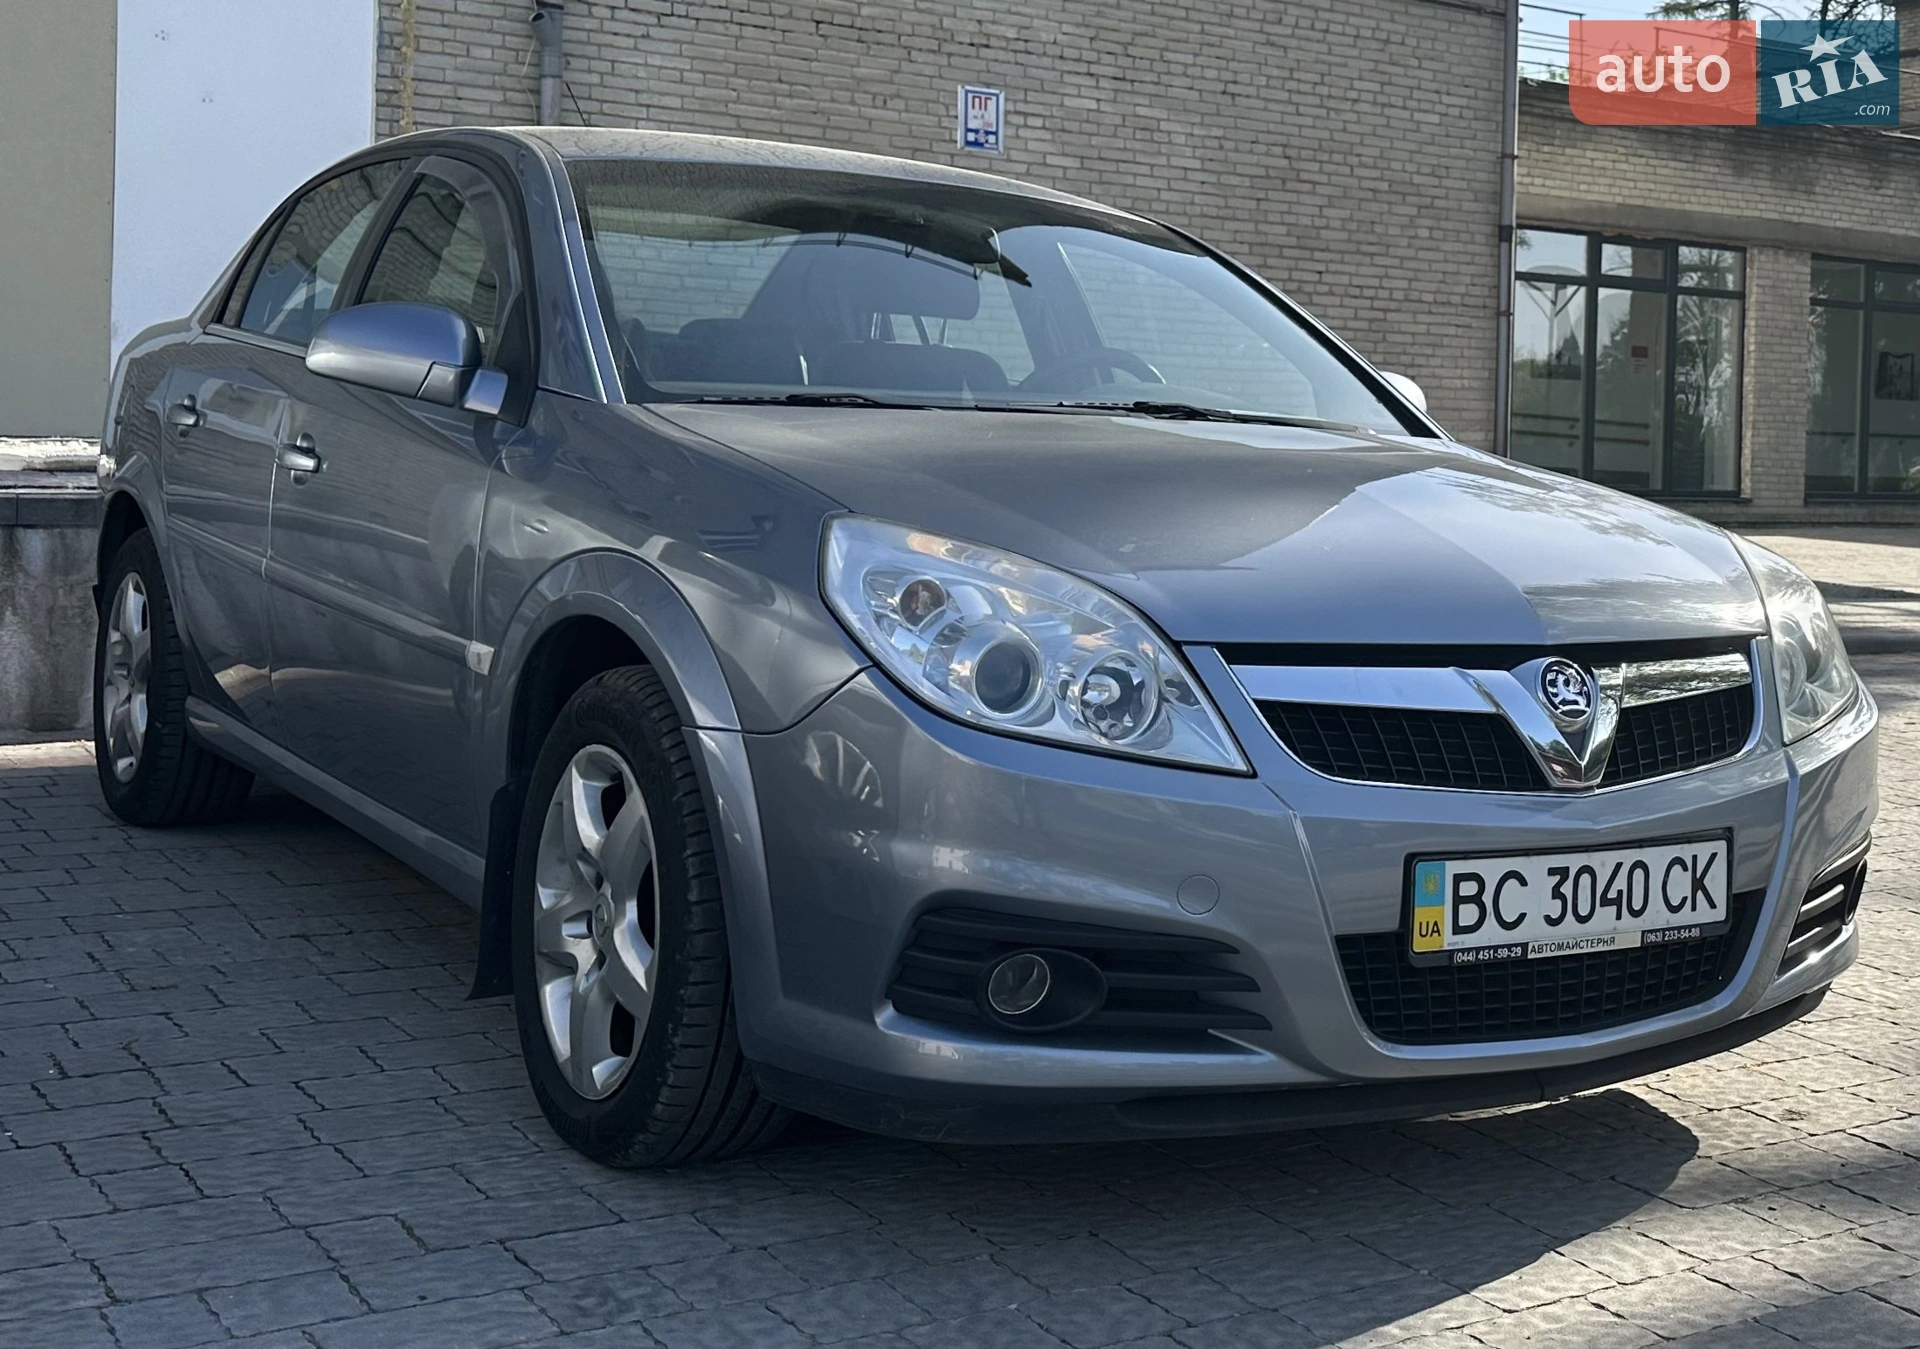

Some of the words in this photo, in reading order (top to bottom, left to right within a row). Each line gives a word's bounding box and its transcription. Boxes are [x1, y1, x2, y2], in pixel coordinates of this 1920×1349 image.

[972, 95, 992, 111] ПГ
[1452, 869, 1529, 936] BC
[1542, 859, 1651, 928] 3040
[1661, 852, 1718, 914] CK
[1418, 919, 1442, 938] UA
[1643, 930, 1663, 945] (063)
[1529, 935, 1616, 956] АВТОМАЙСТЕРНЯ
[1452, 949, 1477, 964] (044)
[1478, 946, 1523, 961] 451-59-29
